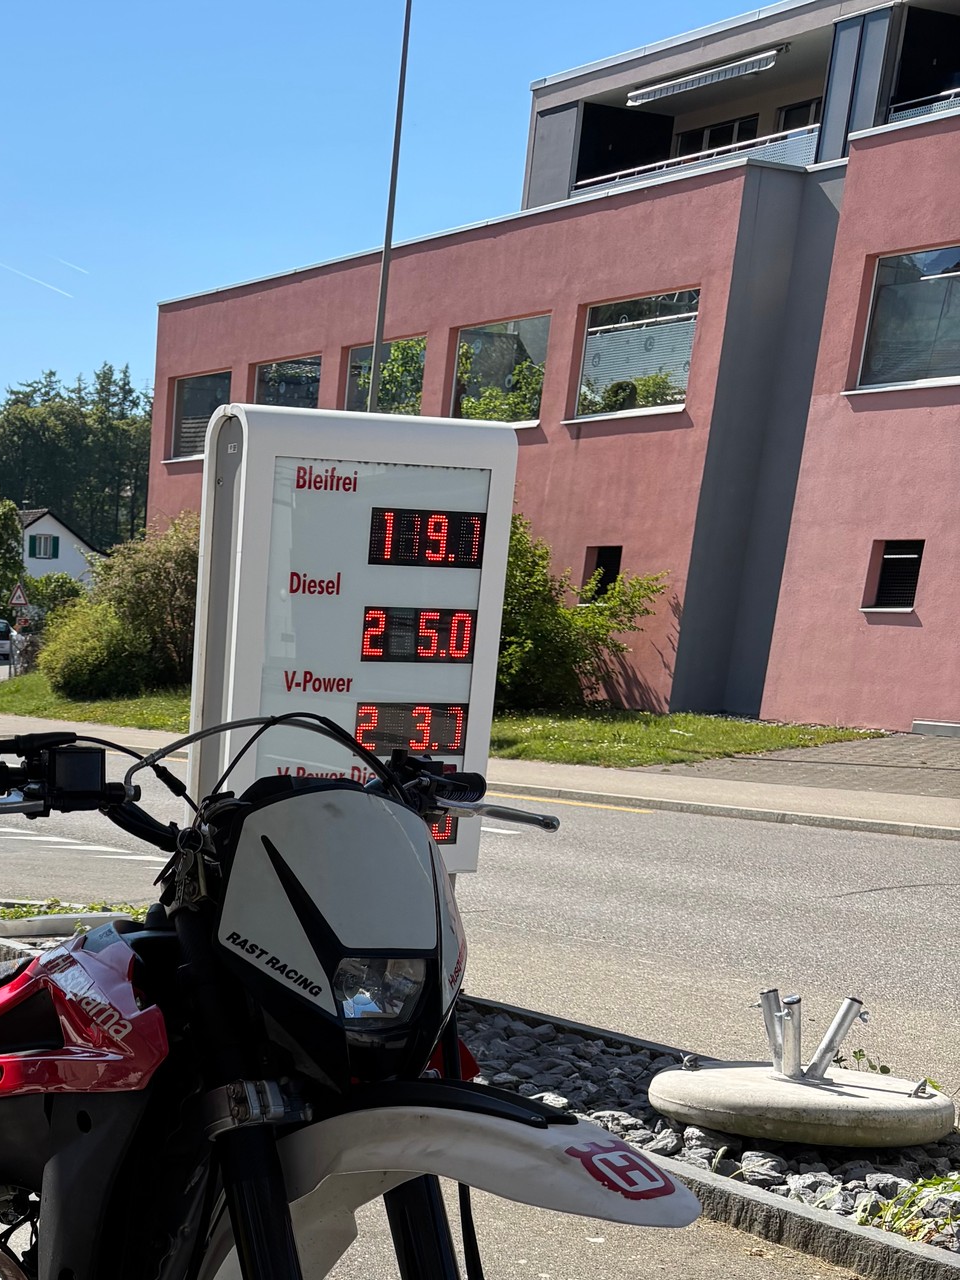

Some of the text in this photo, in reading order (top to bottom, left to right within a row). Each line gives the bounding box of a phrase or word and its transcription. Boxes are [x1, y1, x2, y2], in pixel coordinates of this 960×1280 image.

[295, 465, 358, 492] Bleifrei
[289, 571, 342, 596] Diesel
[283, 670, 353, 693] V-Power
[276, 766, 346, 779] VPower
[225, 931, 323, 998] RAST RACING
